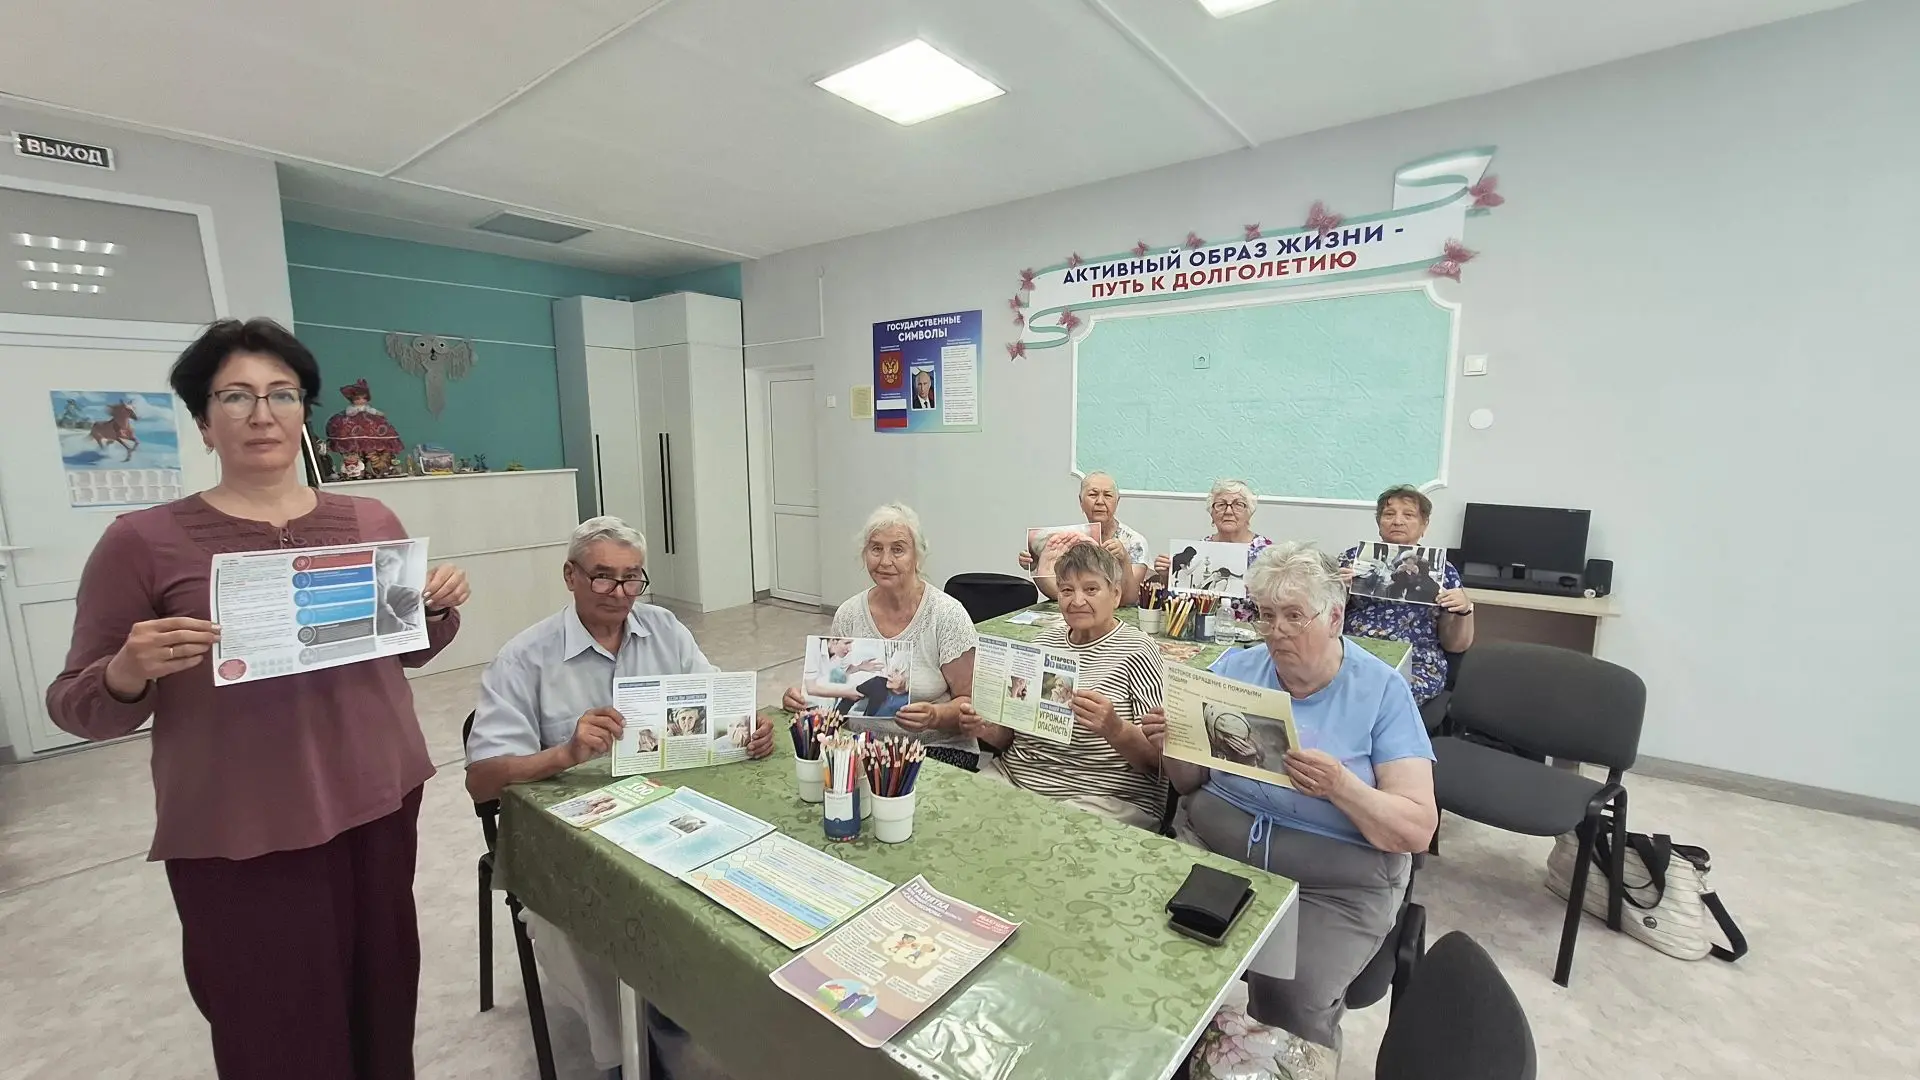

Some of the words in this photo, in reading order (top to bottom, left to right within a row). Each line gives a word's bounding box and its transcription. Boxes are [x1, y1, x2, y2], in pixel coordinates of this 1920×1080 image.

[27, 138, 103, 165] ВЫХОД
[1063, 249, 1181, 284] АКТИВНЫЙ
[1188, 242, 1267, 268] ОБРАЗ
[1276, 224, 1384, 256] ЖИЗНИ
[1092, 281, 1144, 298] ПУТЬ
[1151, 275, 1165, 291] К
[1172, 250, 1357, 291] ДОЛГОЛЕТИЮ
[886, 315, 962, 332] ГОСУДАРСТВЕННЫЕ
[898, 328, 948, 342] СИМВОЛЫ
[1050, 655, 1076, 666] СТАРОСТЬ
[1039, 710, 1071, 726] УГРОЖАЕТ
[908, 882, 950, 911] ПАМЯТКА
